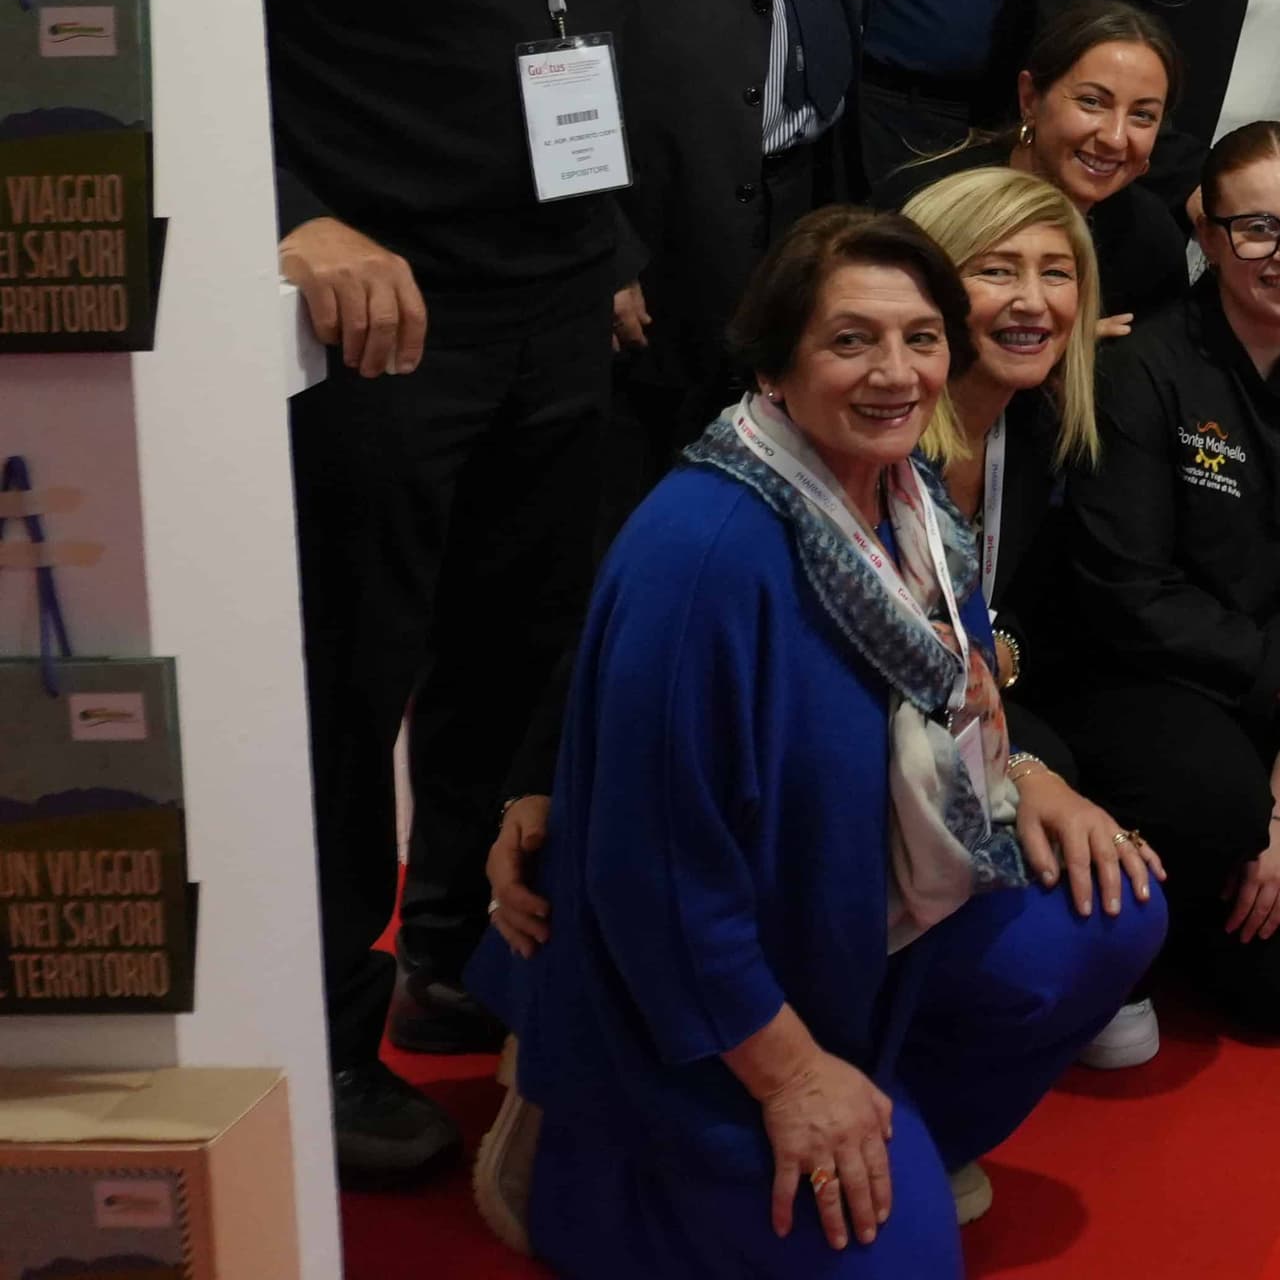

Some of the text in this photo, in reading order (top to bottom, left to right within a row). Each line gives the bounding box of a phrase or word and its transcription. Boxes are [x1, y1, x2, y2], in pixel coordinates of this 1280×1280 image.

[6, 174, 123, 223] VIAGGIO
[24, 229, 125, 278] SAPORI
[0, 284, 128, 333] RRITORIO
[1205, 436, 1246, 463] Molinello
[47, 849, 162, 896] VIAGGIO
[9, 901, 165, 949] NEI SAPORI
[9, 952, 170, 999] TERRITORIO
